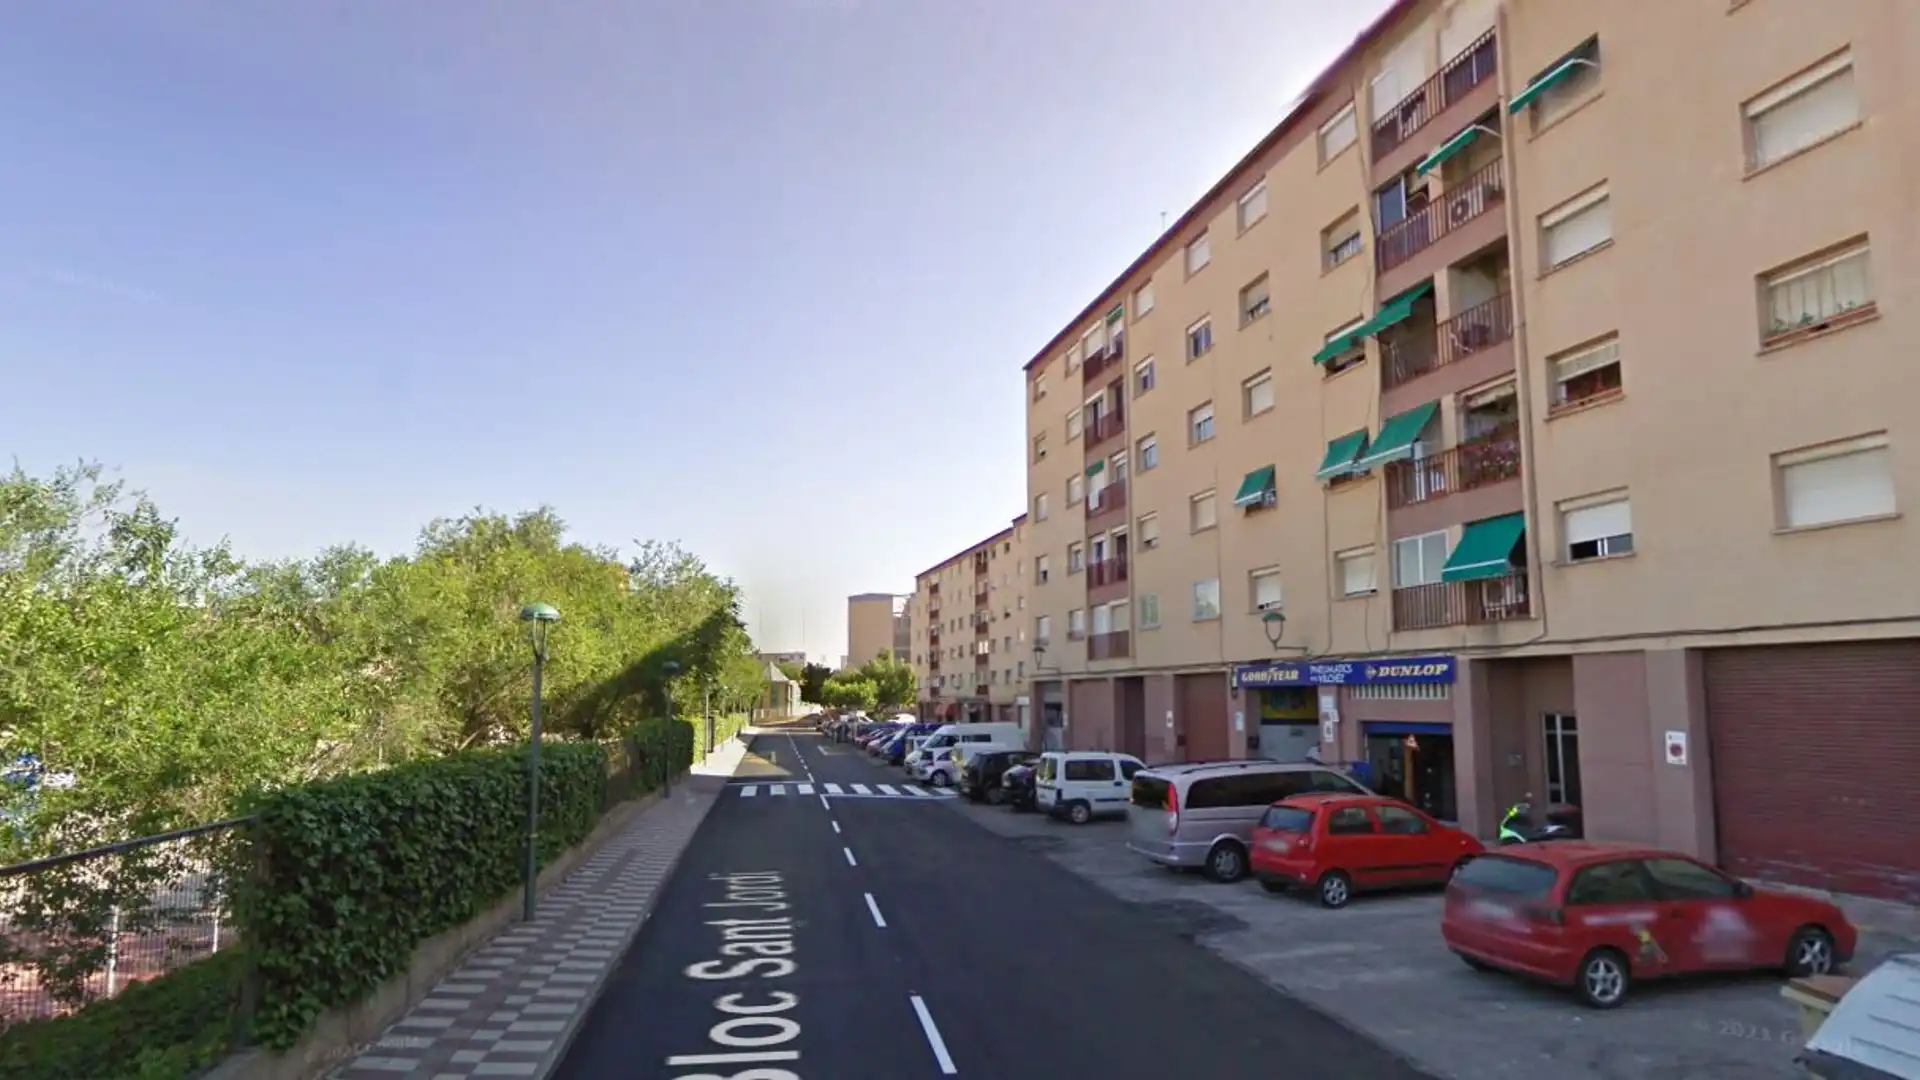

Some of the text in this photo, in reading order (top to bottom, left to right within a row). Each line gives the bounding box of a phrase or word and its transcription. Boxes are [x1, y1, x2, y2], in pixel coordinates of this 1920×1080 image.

[1241, 667, 1299, 684] GOODYEAR
[1378, 663, 1449, 677] DUNLOP
[702, 871, 791, 911] Jordi
[683, 917, 797, 980] Sant
